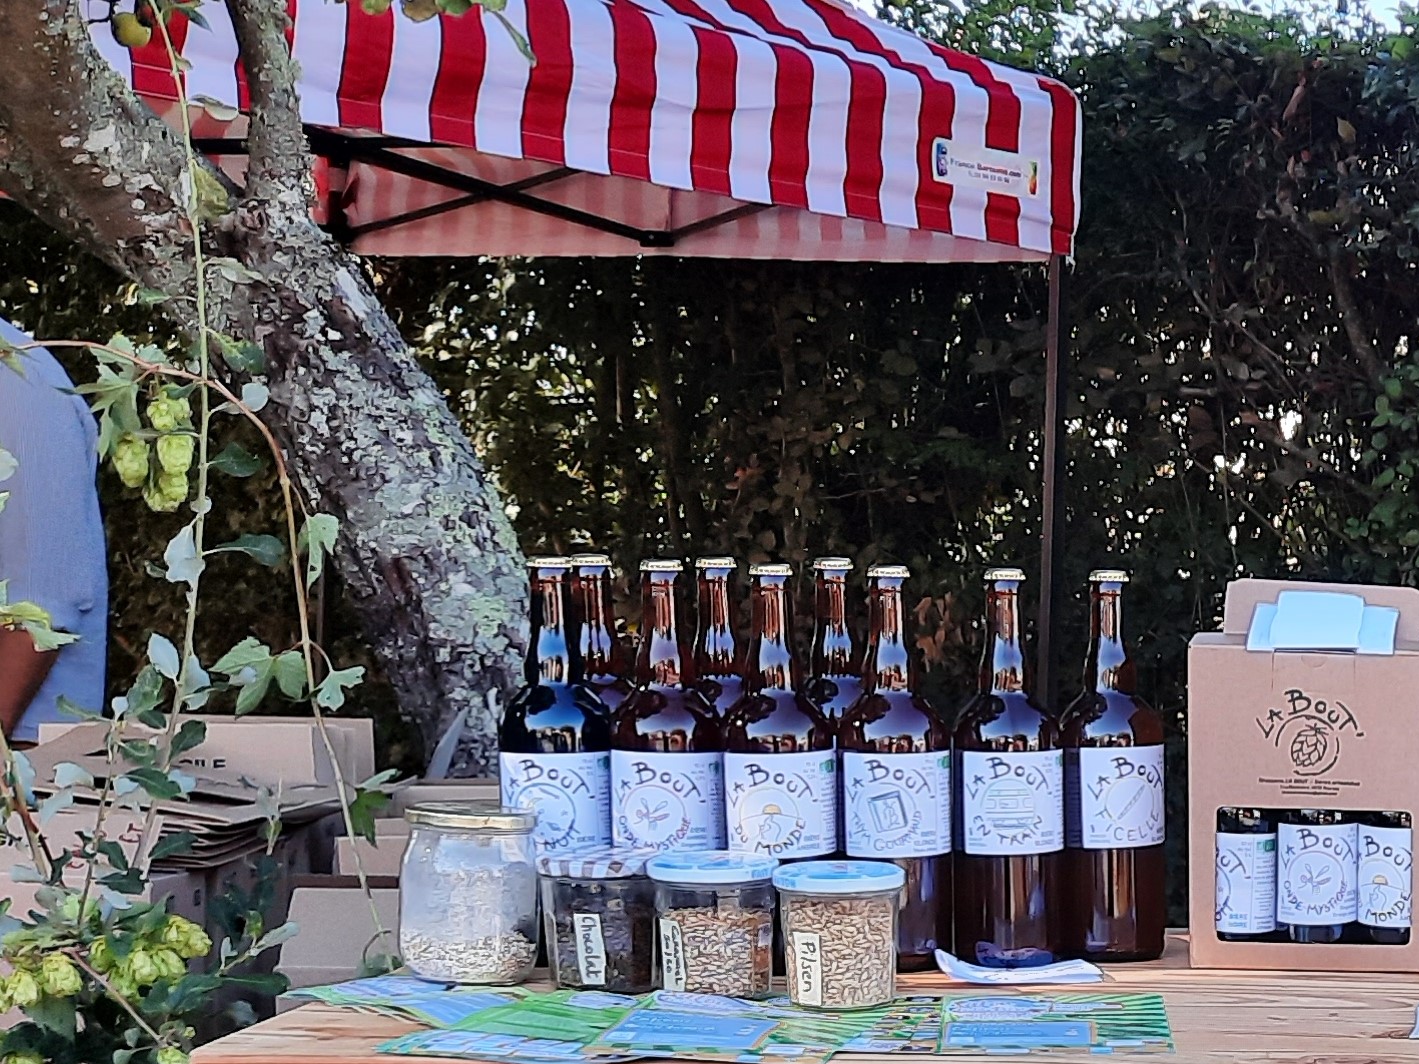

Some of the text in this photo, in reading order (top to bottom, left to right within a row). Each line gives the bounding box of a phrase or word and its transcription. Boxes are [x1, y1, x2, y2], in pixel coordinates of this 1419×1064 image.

[1255, 709, 1284, 739] LA
[966, 775, 985, 800] LA
[1087, 775, 1111, 801] LA
[800, 941, 817, 992] Pilsen
